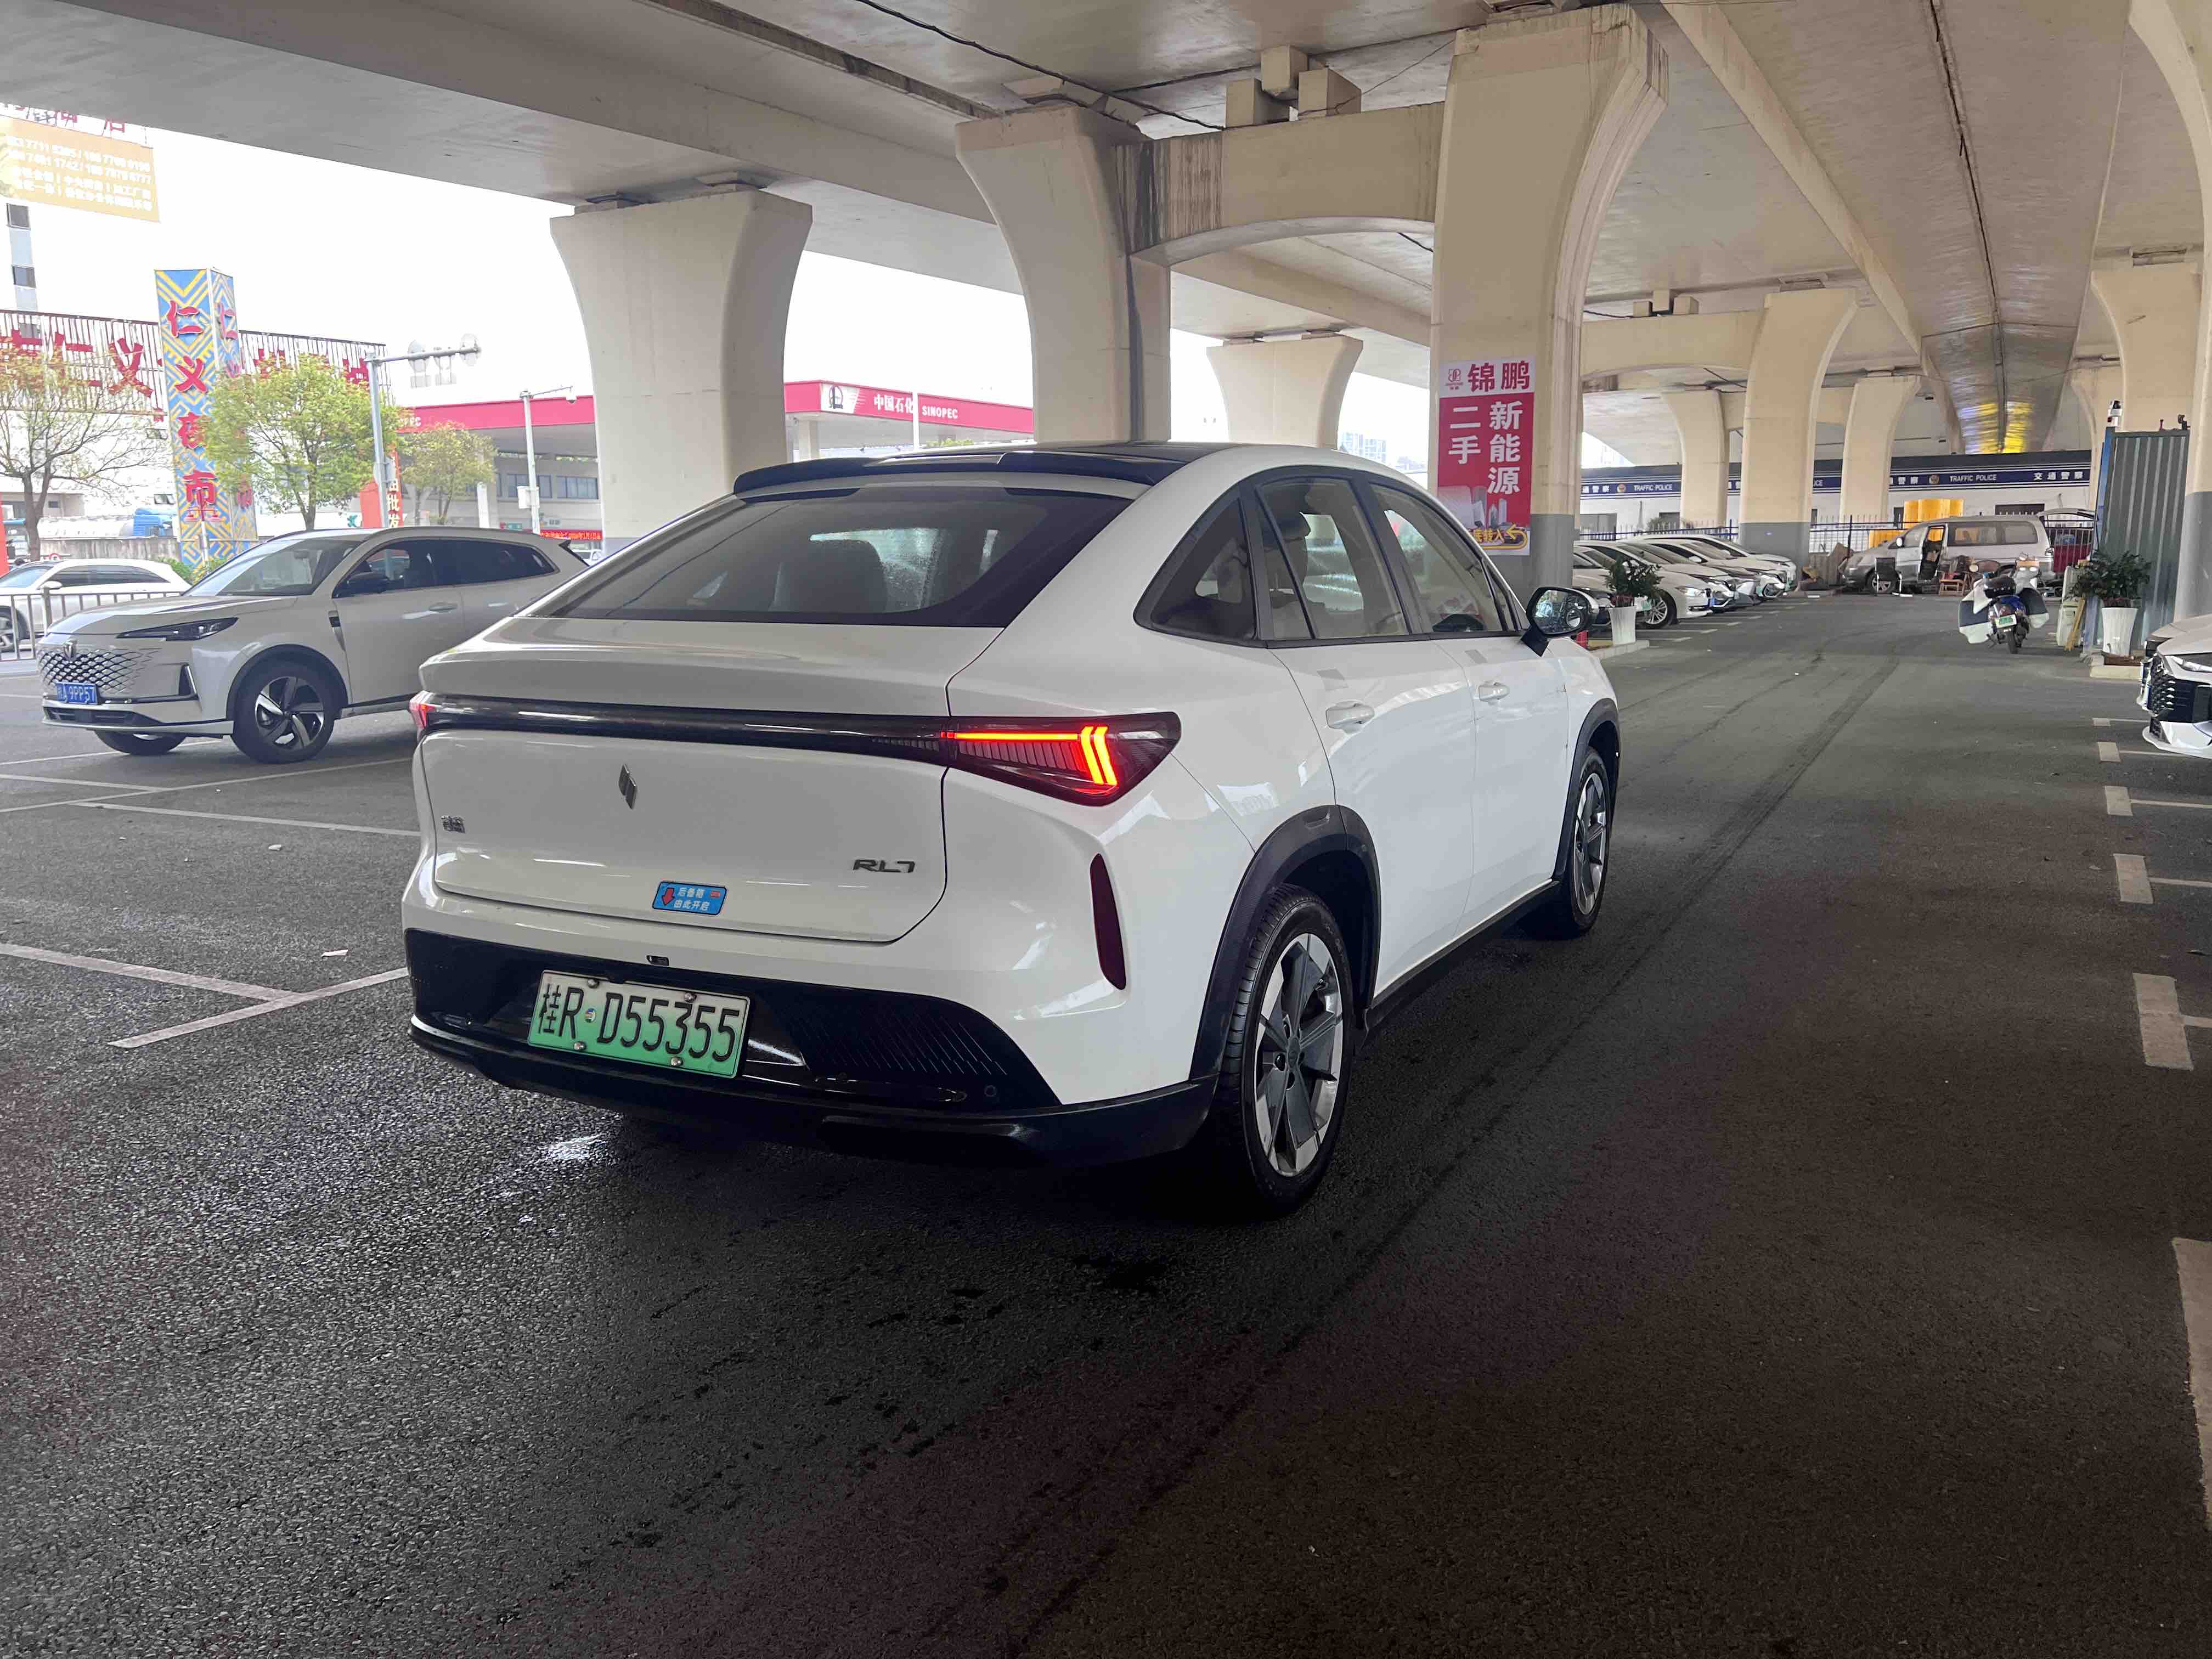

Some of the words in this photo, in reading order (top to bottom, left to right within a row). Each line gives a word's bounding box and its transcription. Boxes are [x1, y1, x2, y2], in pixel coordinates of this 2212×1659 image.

[1467, 360, 1530, 392] 锦鹏
[873, 393, 913, 414] 中国石化
[922, 405, 958, 419] SINOPEC
[1448, 406, 1481, 465] 二手
[1487, 400, 1523, 495] 新能源
[2033, 471, 2084, 481] 交通警察
[853, 859, 916, 873] RL7
[674, 899, 710, 911] 由此开启
